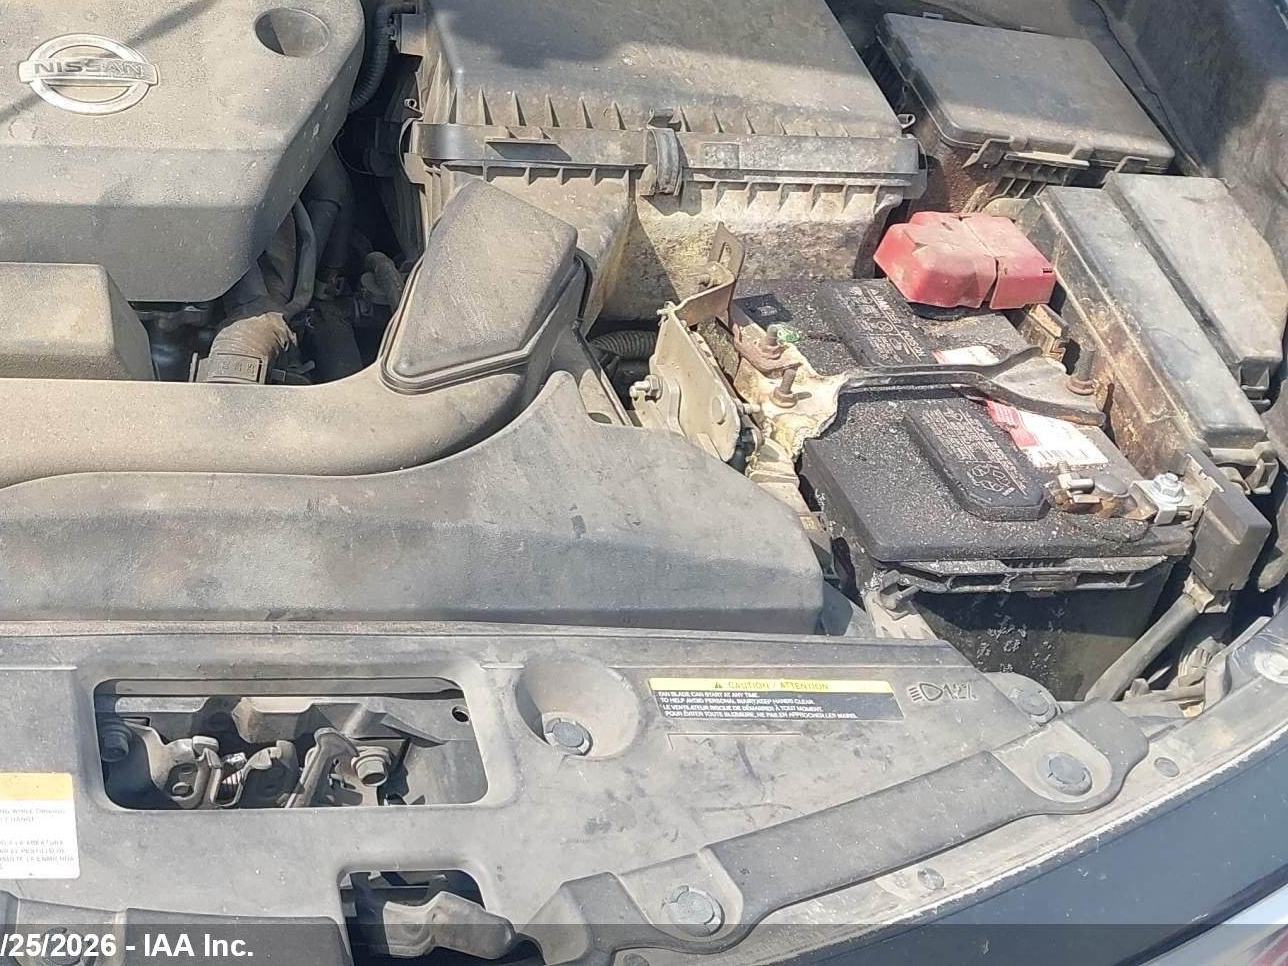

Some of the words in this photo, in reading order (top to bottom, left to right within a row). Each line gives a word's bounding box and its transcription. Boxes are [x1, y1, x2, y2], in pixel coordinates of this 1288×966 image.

[33, 60, 143, 79] NISSAN
[728, 681, 769, 689] CAUTION
[780, 682, 830, 690] ATTENTION
